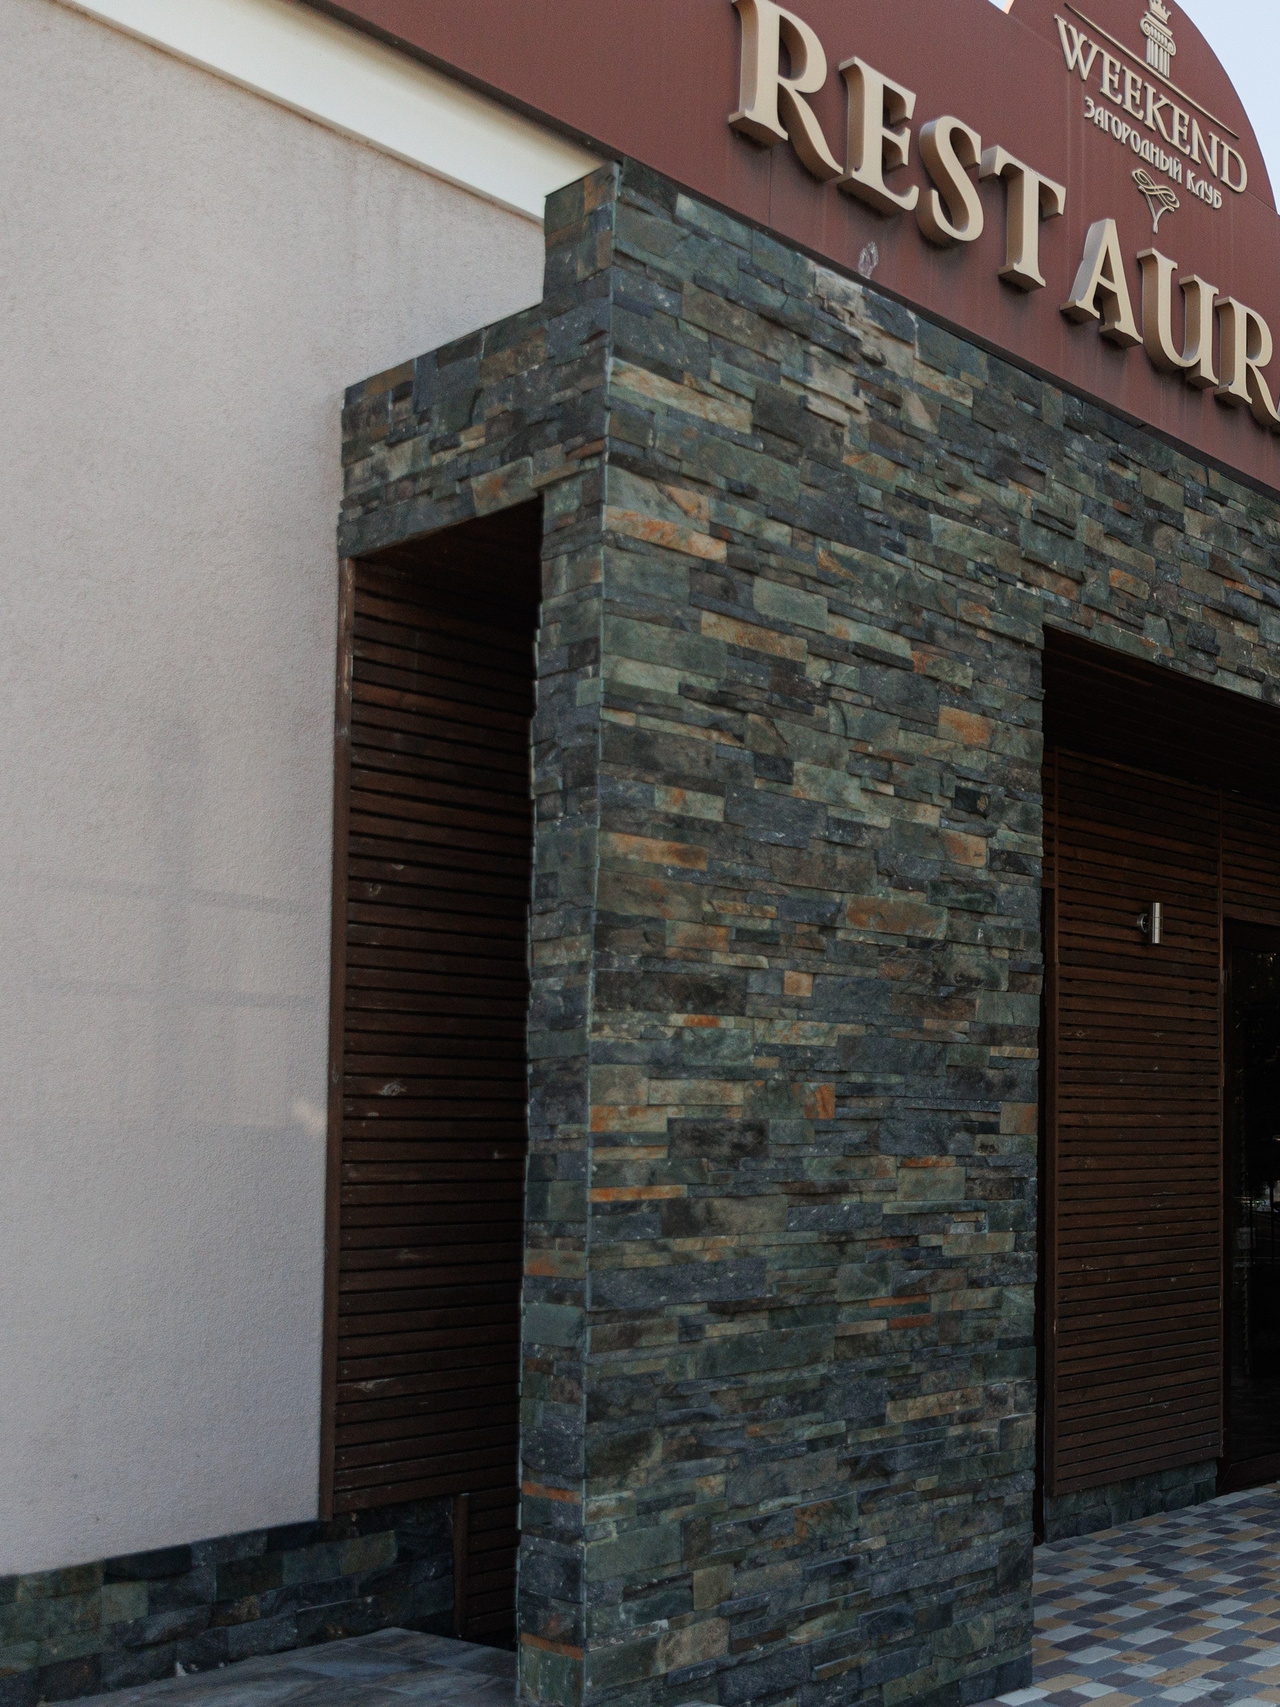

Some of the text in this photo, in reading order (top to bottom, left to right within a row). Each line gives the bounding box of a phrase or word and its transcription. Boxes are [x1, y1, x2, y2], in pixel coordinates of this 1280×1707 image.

[1053, 13, 1249, 194] WEEKEND
[1083, 96, 1223, 209] ЗАГОРОДНЫЙ КЛУБ
